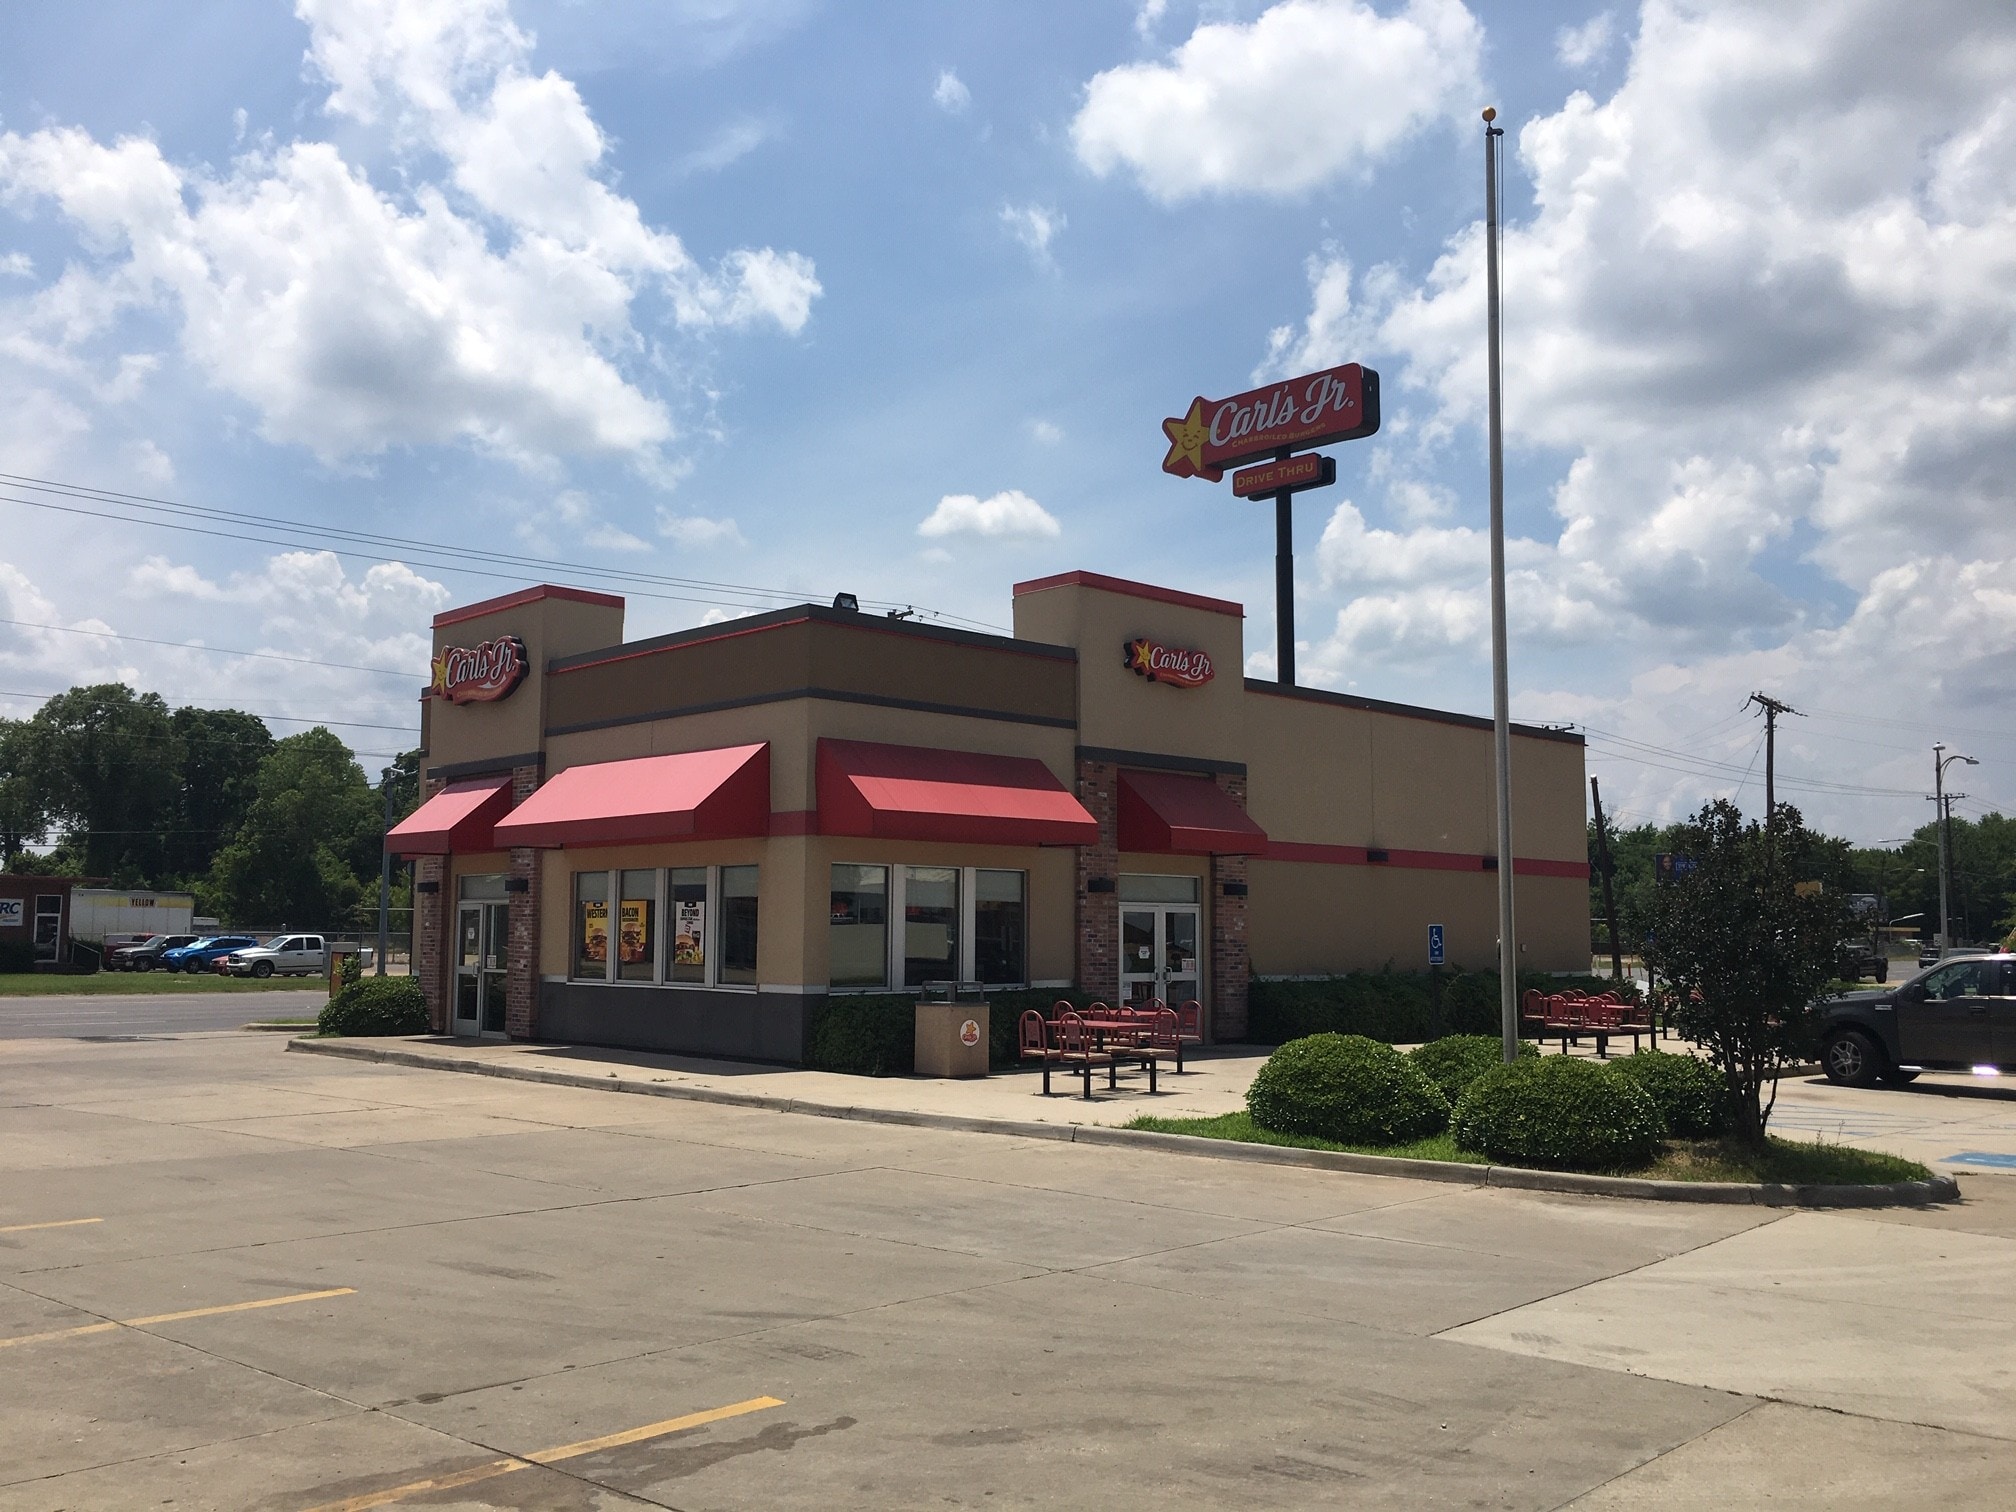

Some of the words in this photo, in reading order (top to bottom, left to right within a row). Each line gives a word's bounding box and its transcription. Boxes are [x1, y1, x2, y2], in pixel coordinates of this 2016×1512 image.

[1209, 385, 1300, 446] Carl's
[1301, 374, 1355, 424] Jr.
[1236, 471, 1274, 488] DRIVE
[1277, 462, 1314, 479] THRU
[445, 646, 490, 689] Carl's
[490, 641, 516, 680] Jr.
[1150, 646, 1190, 672] Carl's
[1190, 653, 1214, 676] Jr.
[131, 898, 155, 907] YELLOW
[621, 907, 640, 918] BACON
[681, 908, 700, 917] BEYOND
